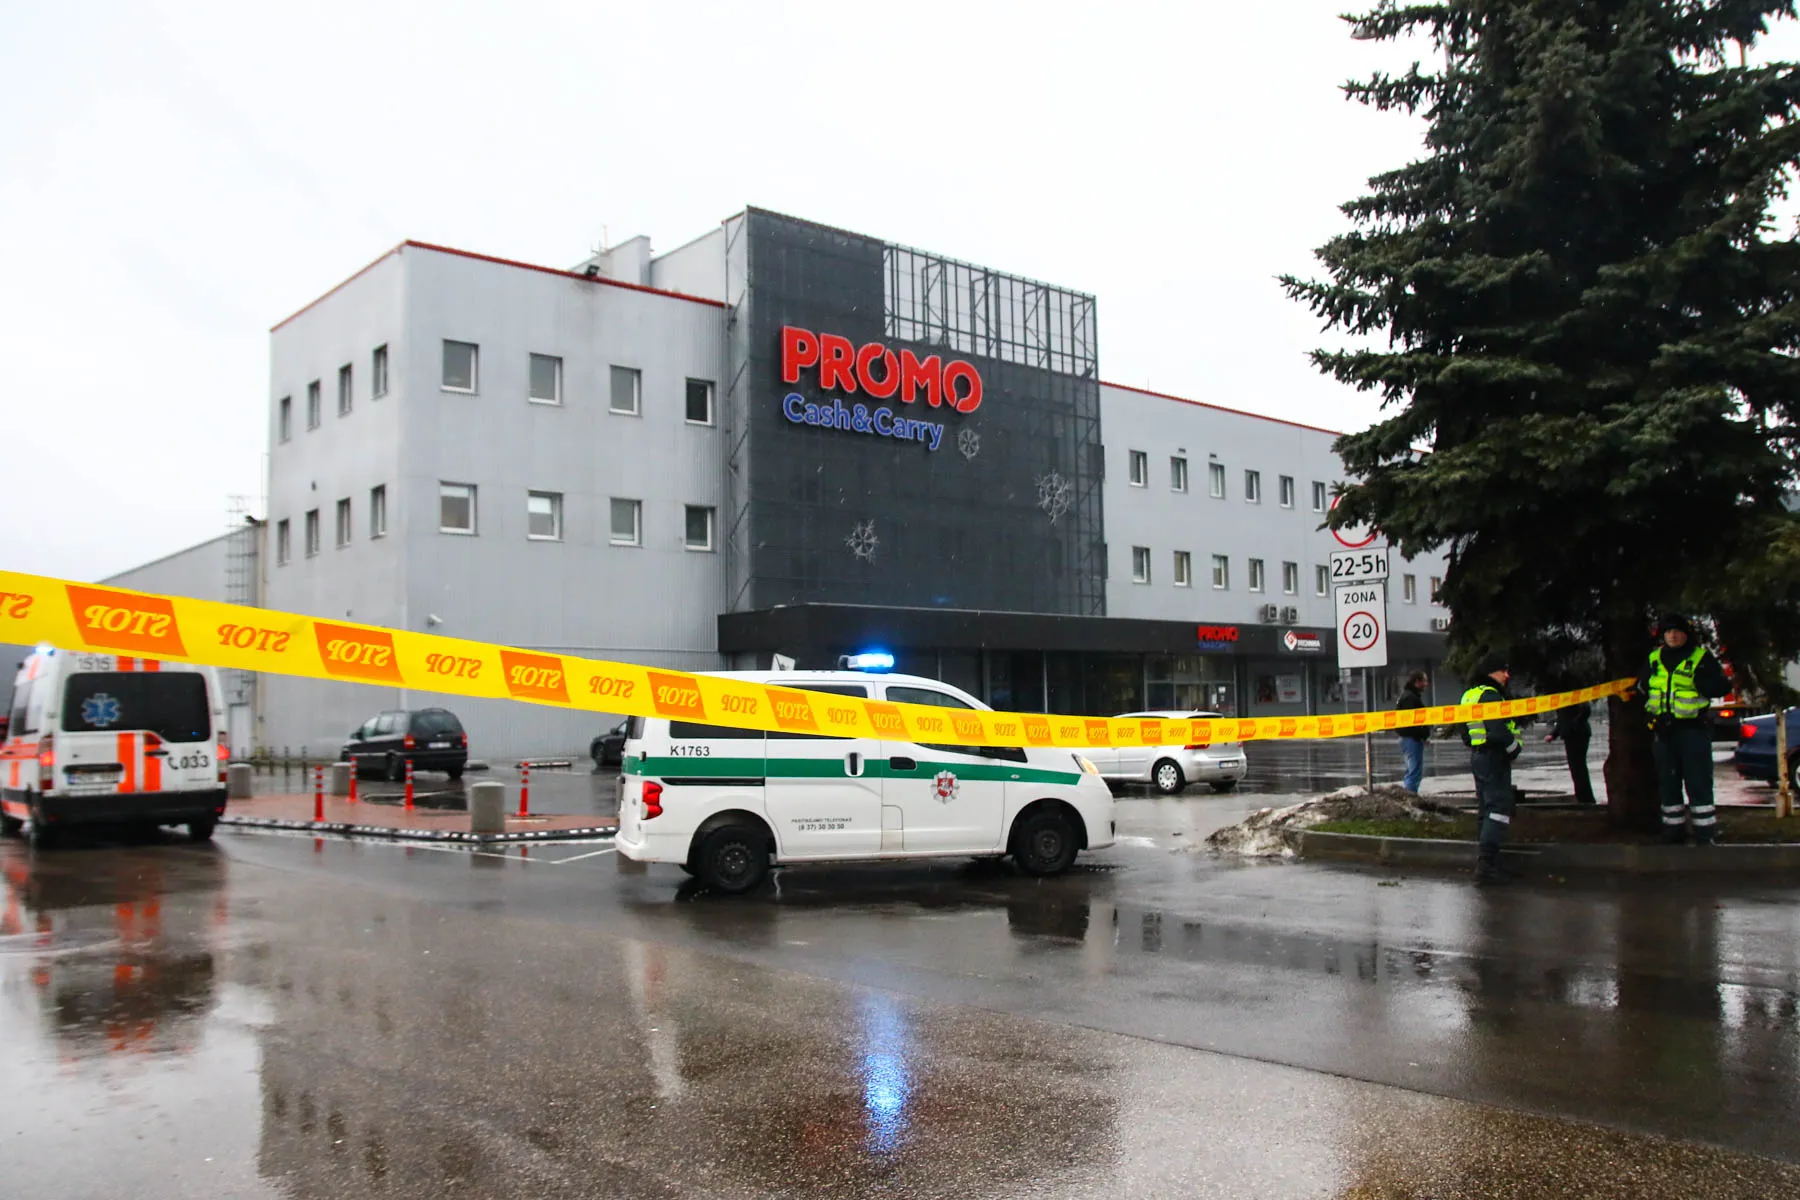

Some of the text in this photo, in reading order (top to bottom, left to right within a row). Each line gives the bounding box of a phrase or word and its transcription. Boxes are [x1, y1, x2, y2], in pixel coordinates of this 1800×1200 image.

[781, 325, 983, 413] PROMO
[783, 393, 944, 450] Cash&Carry
[1333, 555, 1386, 577] 22-5h
[1344, 591, 1377, 604] ZONA
[1352, 623, 1372, 639] 20
[670, 745, 710, 757] K1763
[180, 755, 209, 769] 033
